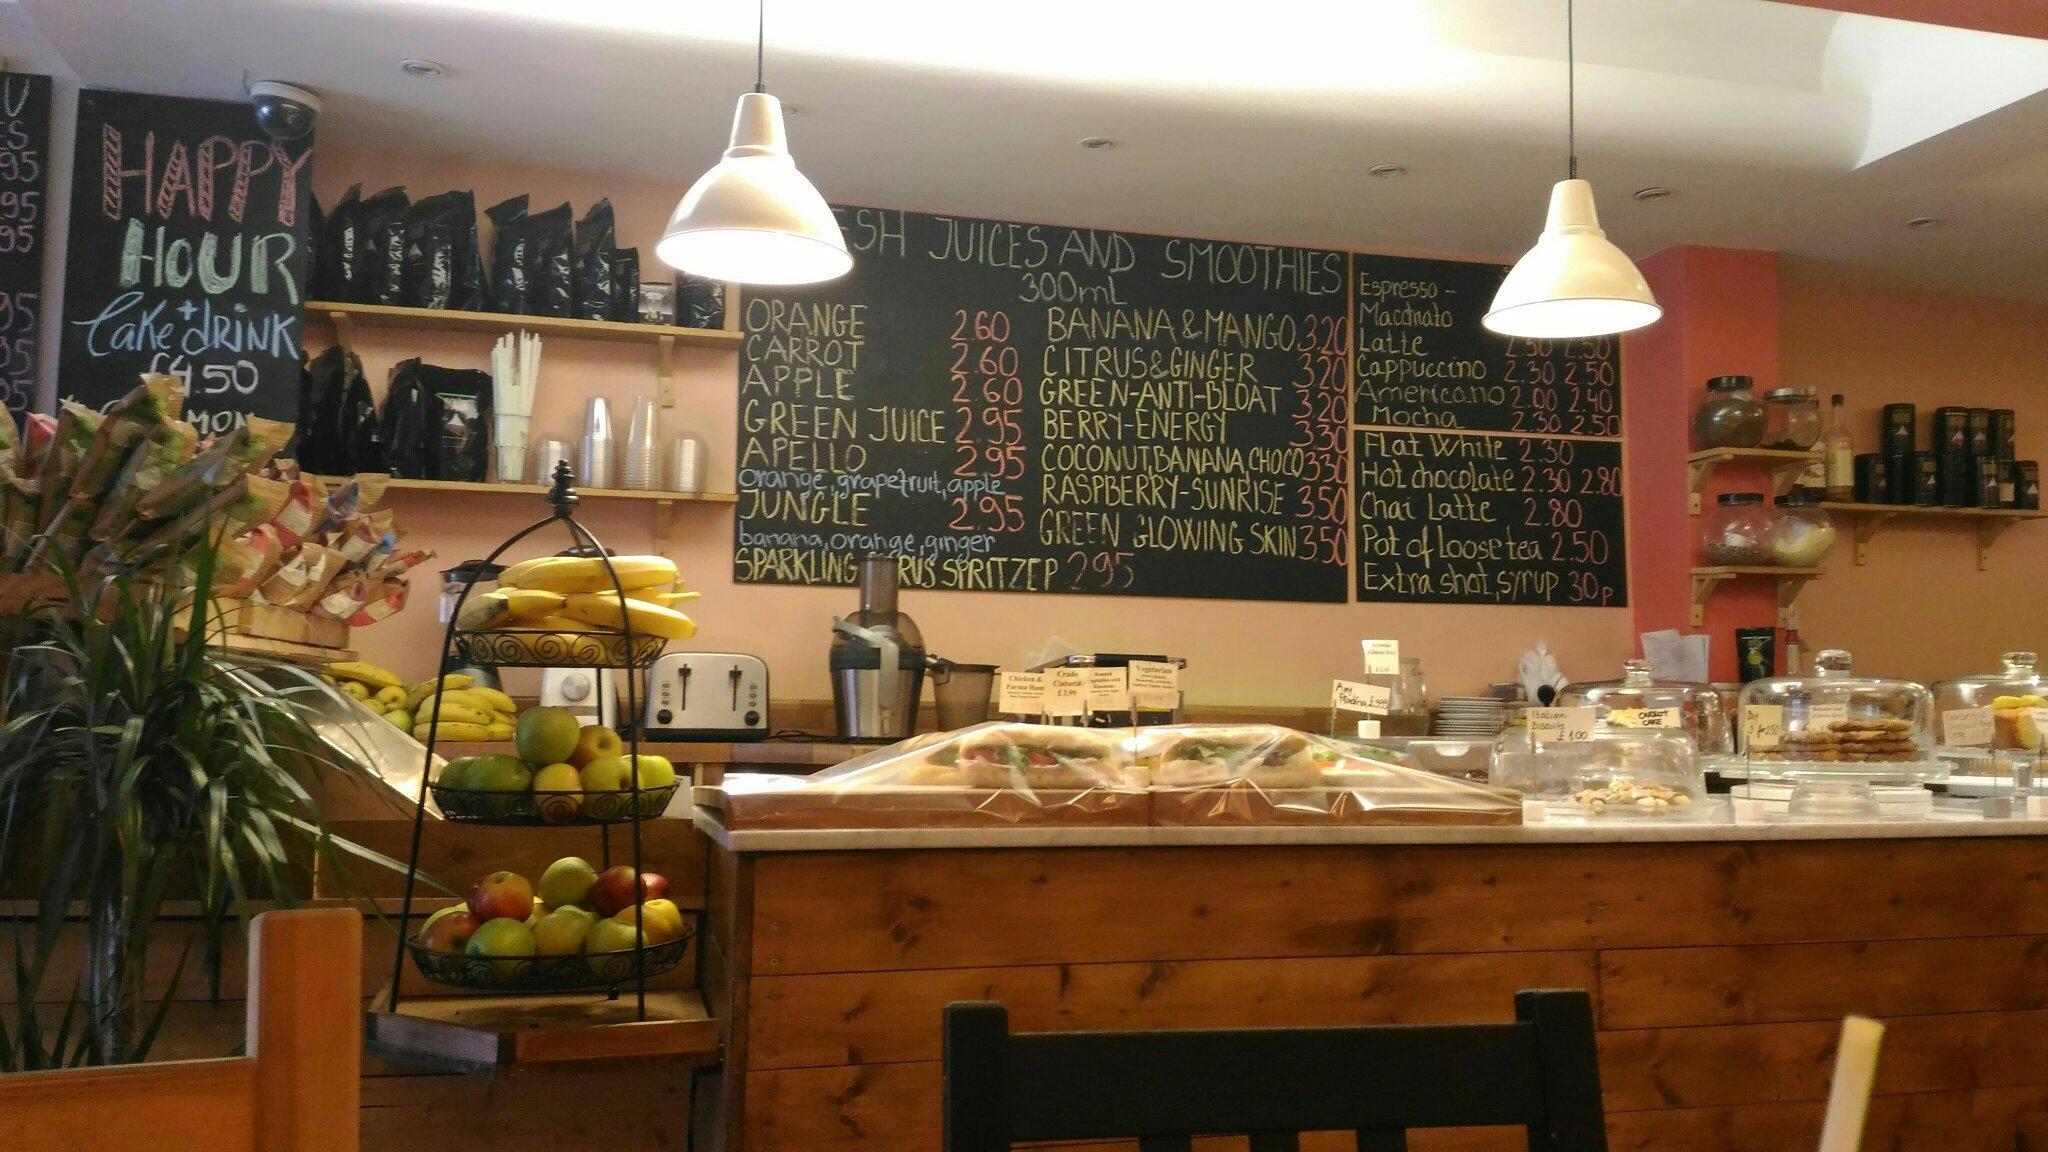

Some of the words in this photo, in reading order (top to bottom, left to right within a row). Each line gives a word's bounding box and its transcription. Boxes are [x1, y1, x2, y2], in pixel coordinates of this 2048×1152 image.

[103, 122, 312, 227] HAPPY
[119, 218, 299, 305] HOUR
[929, 216, 1048, 269] JUICES
[1058, 229, 1136, 273] AND
[1161, 238, 1342, 295] SMOOTHIES
[1360, 272, 1438, 302] Espresso
[745, 298, 868, 339] ORANGE
[1048, 305, 1177, 344] BANANA
[1205, 309, 1296, 351] MANGO
[746, 334, 865, 369] CARROT
[1359, 327, 1429, 356] Latte
[742, 365, 855, 401] APPLE
[1357, 354, 1487, 382] Cappuccino
[1504, 360, 1556, 385] 2.30
[1564, 361, 1615, 387] 2.50
[1354, 380, 1505, 405] Americano
[1510, 386, 1557, 412] 2.00
[1569, 387, 1614, 413] 2.40
[744, 399, 858, 439] GREEN
[868, 405, 946, 443] JUICE
[1372, 405, 1464, 429] Mocha
[1511, 412, 1562, 434] 2.30
[1570, 413, 1621, 437] 2.50
[741, 437, 867, 473] APELLO
[1364, 432, 1423, 458] Flat
[1430, 434, 1508, 461] White
[1518, 438, 1575, 466] 2.30
[1361, 459, 1406, 488] Hot
[1411, 460, 1516, 493] chocolate
[1520, 465, 1572, 494] 2.30
[740, 488, 871, 526] JUNGLE
[1359, 490, 1415, 521] Chai
[1428, 493, 1497, 522] Latte
[1523, 497, 1583, 528] 2.80
[1040, 508, 1120, 547] GREEN
[1133, 513, 1244, 555] GLOWING
[1250, 522, 1297, 558] SKIN
[1362, 524, 1401, 556] Pot
[1406, 525, 1434, 568] of
[1438, 525, 1502, 560] loose
[1507, 525, 1543, 560] tea
[1551, 531, 1609, 565] 2.50
[735, 547, 859, 584] SPARKLING
[1364, 562, 1434, 595] Extra
[1531, 708, 1567, 719] Italian
